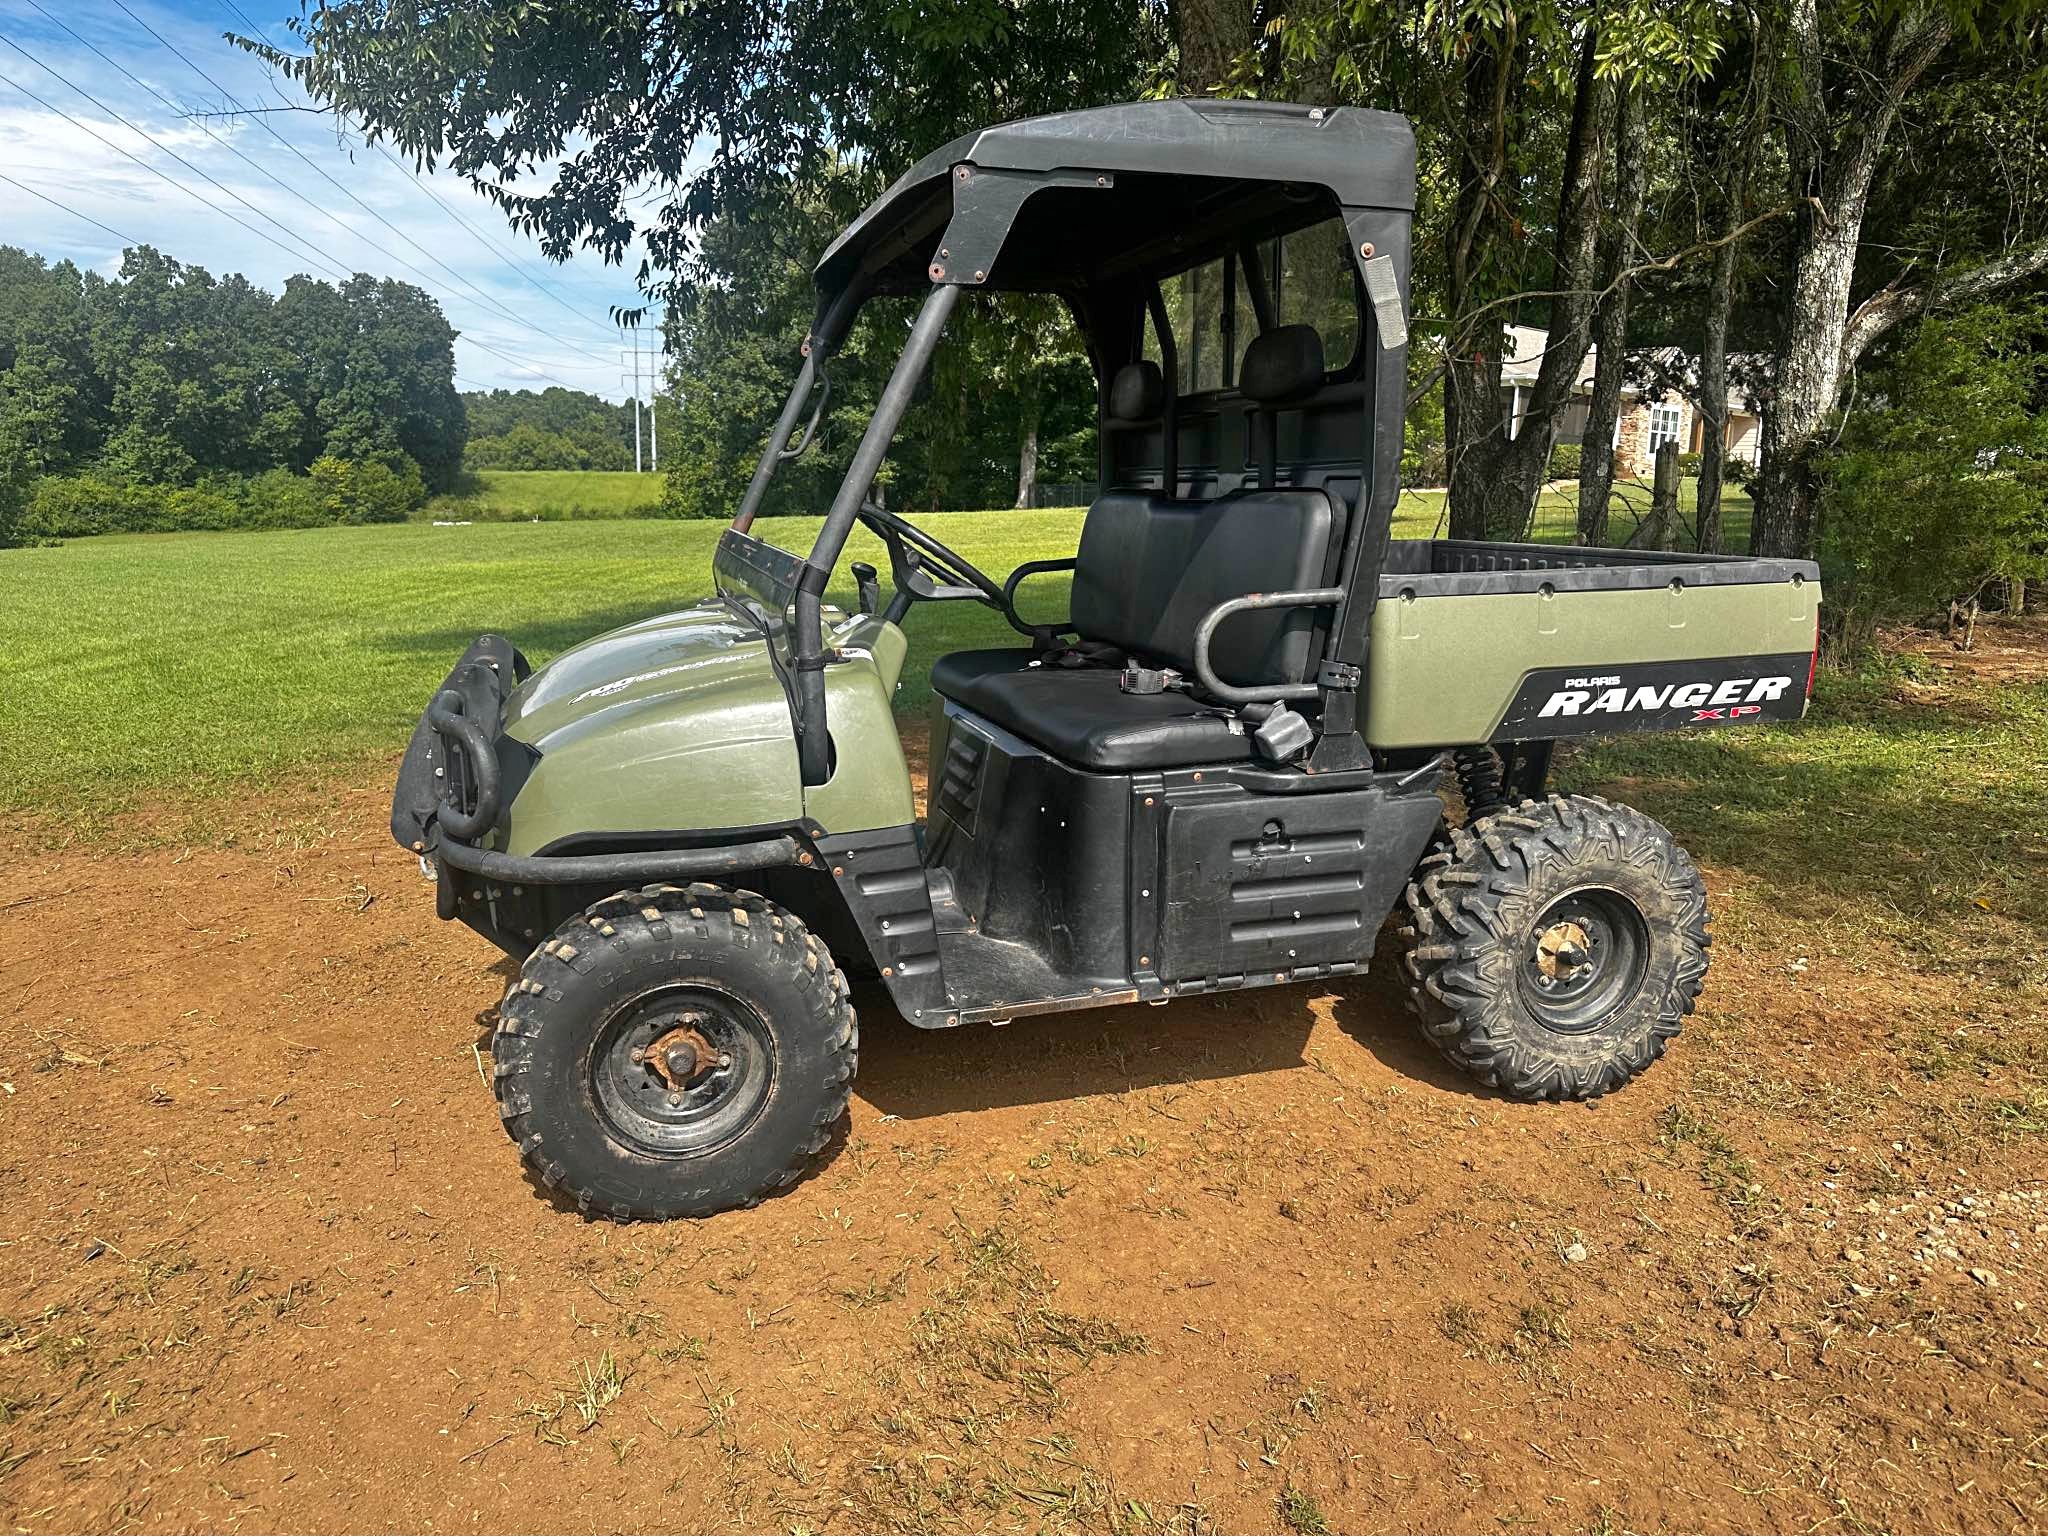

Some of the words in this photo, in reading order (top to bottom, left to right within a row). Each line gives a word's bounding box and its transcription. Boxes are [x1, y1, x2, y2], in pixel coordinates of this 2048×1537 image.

[1565, 676, 1621, 688] POLARIS
[1537, 676, 1792, 717] RANGER
[1690, 705, 1762, 721] XP
